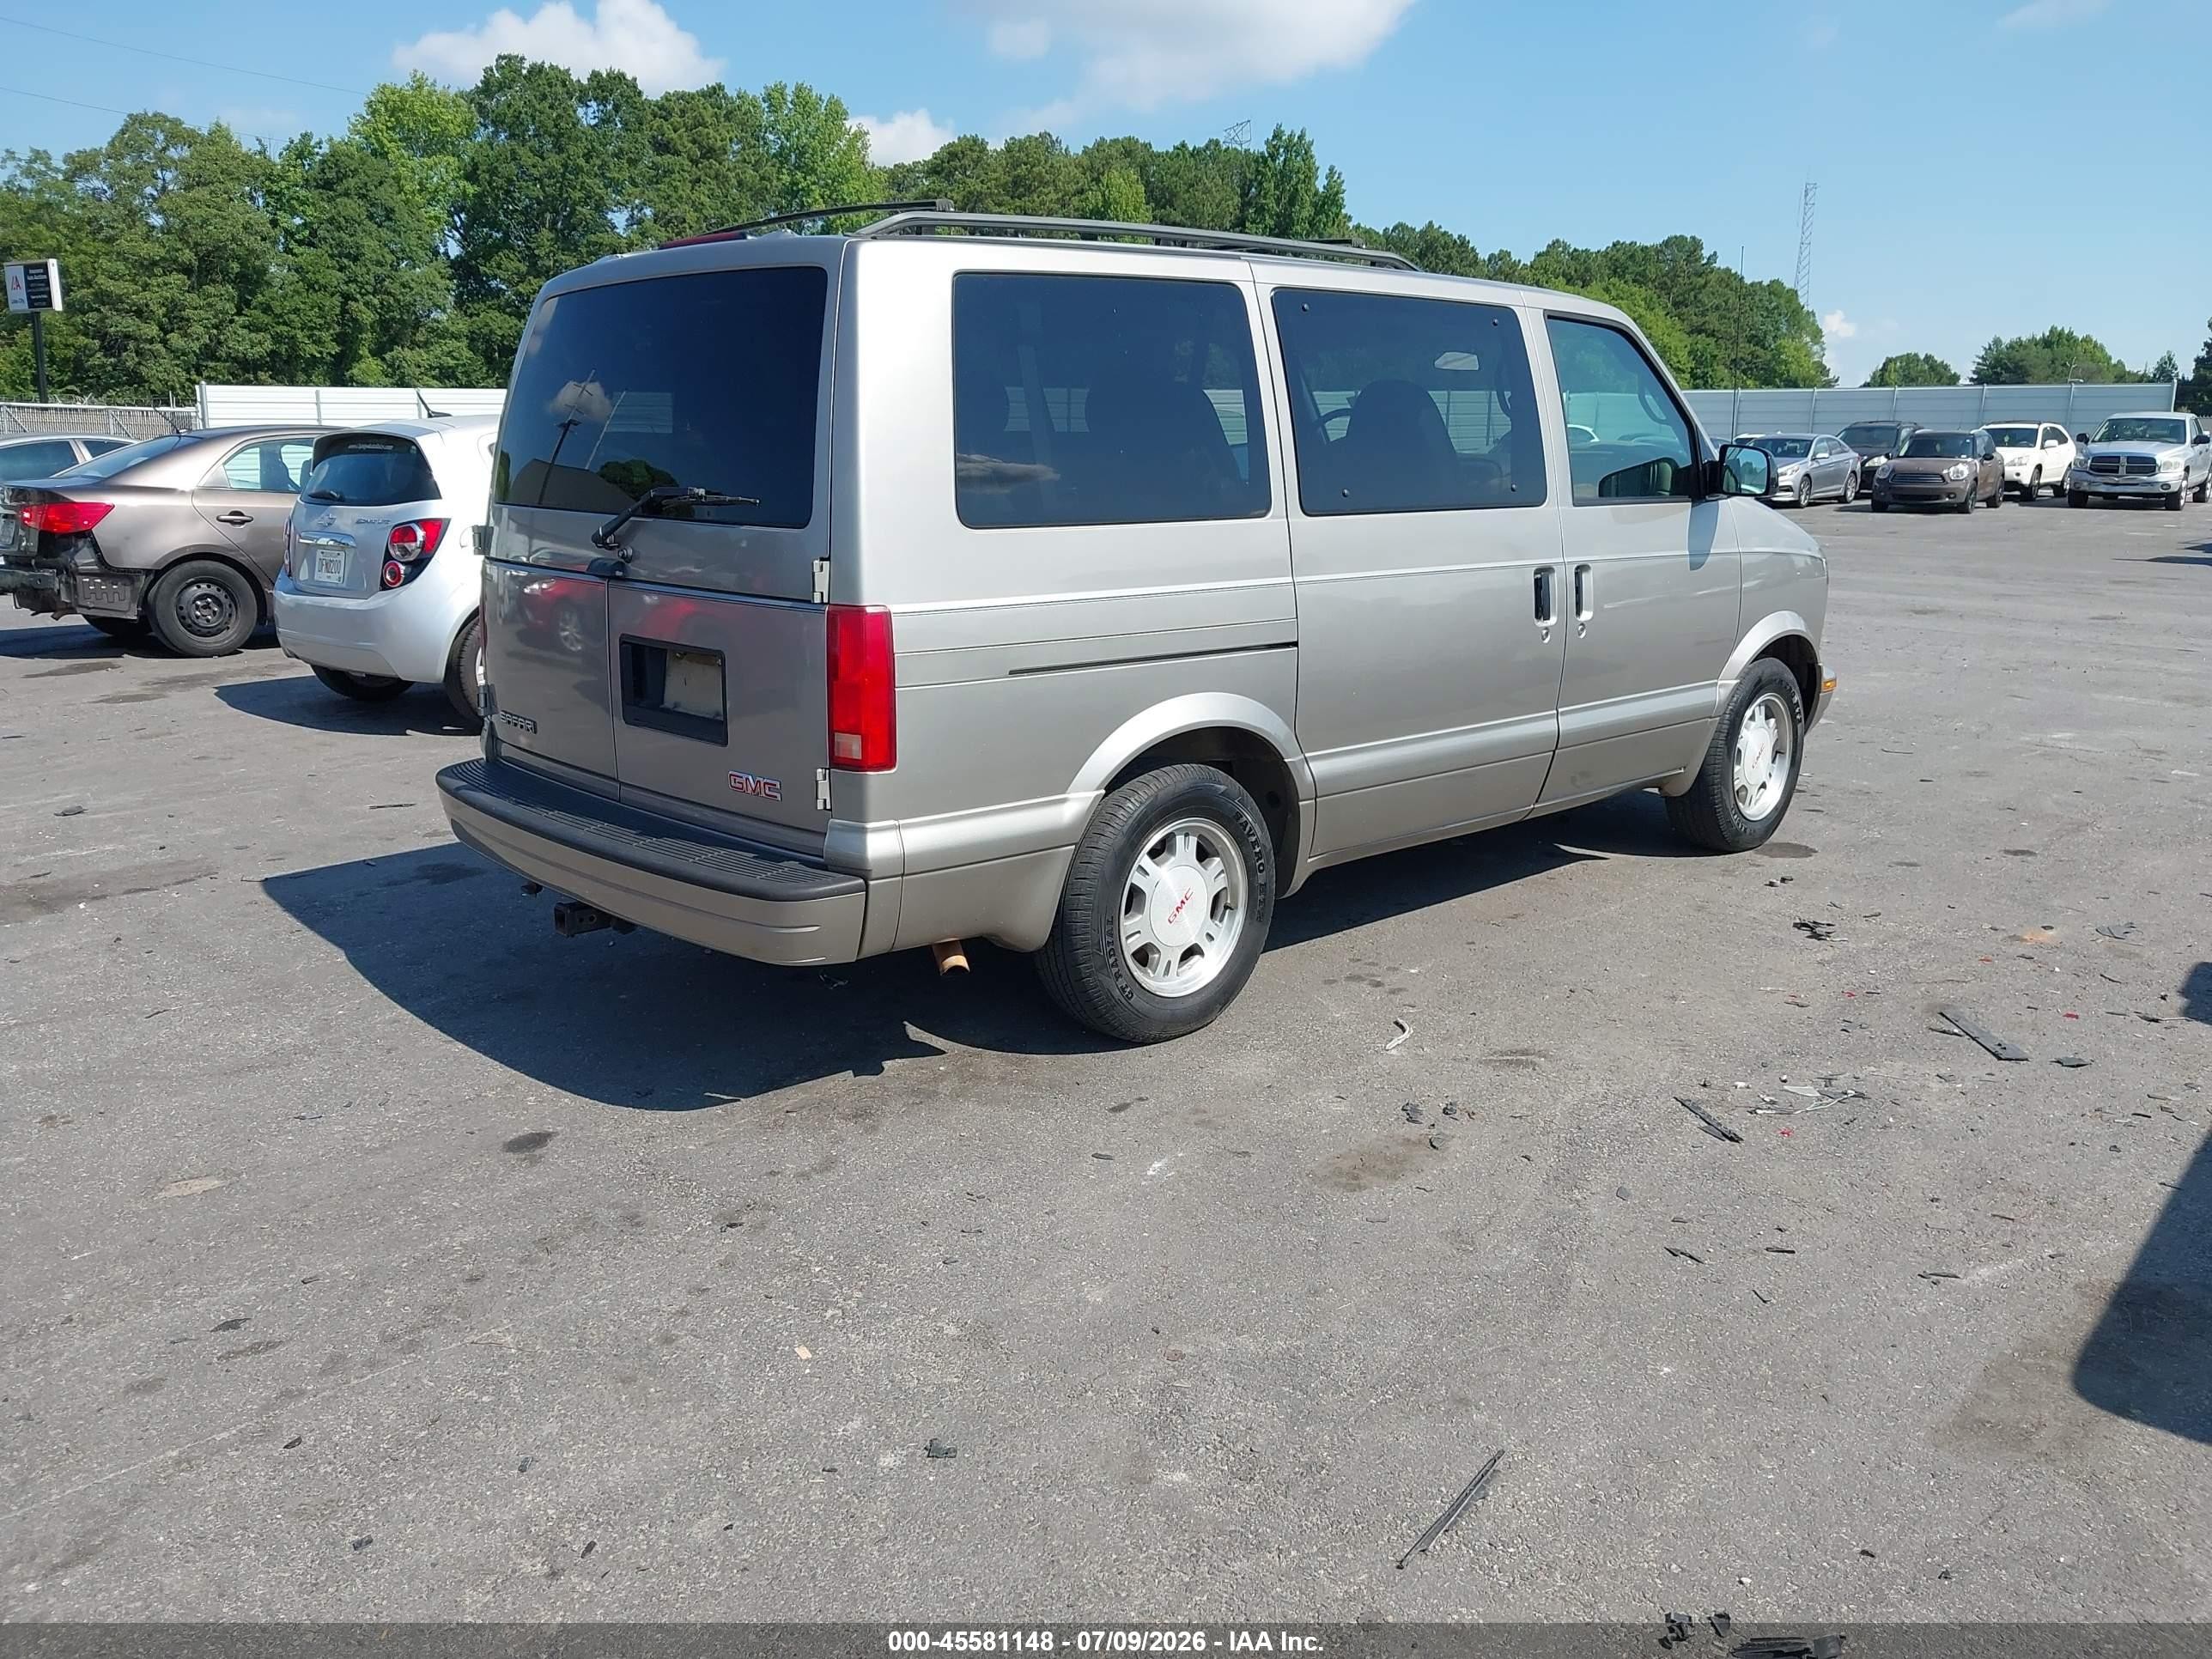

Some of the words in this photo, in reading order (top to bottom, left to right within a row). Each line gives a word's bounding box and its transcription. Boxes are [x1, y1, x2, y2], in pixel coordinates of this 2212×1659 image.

[500, 710, 538, 734] SAFARI
[728, 770, 782, 801] GMC
[1167, 886, 1194, 925] GMC
[1105, 915, 1123, 981] RADIAL
[1119, 982, 1134, 1001] GT
